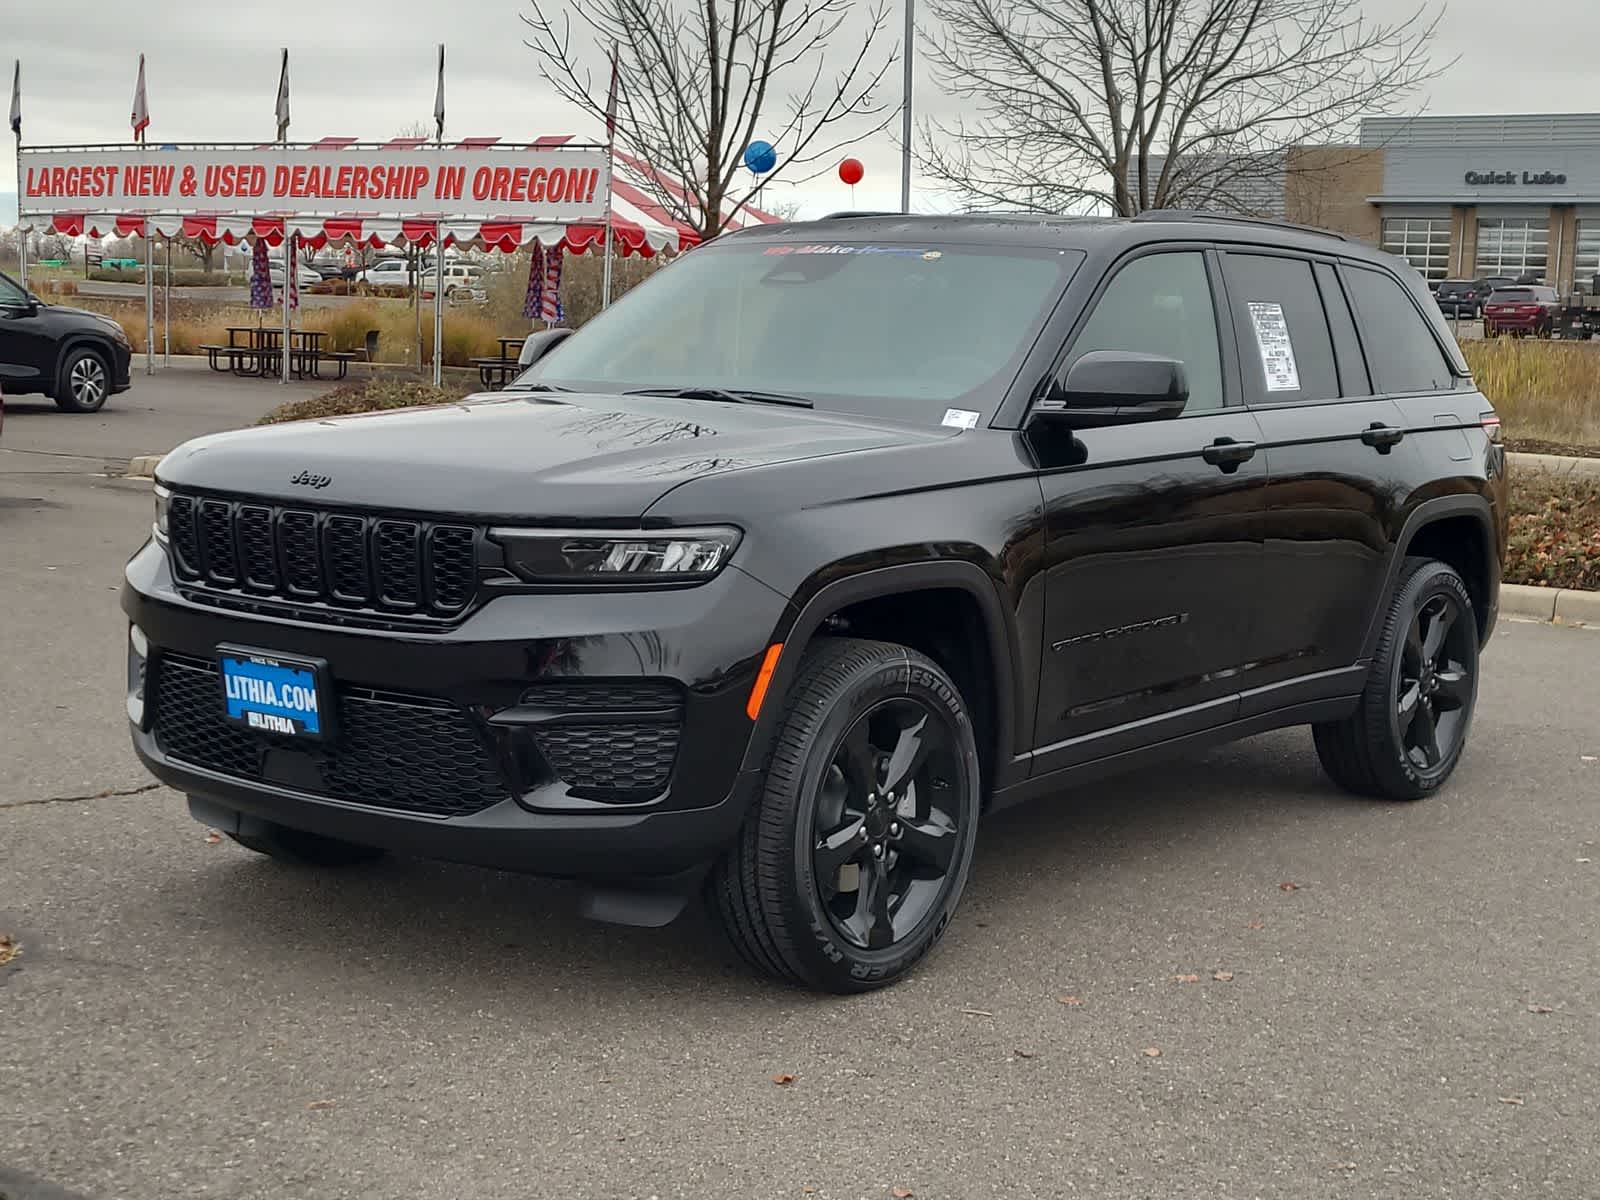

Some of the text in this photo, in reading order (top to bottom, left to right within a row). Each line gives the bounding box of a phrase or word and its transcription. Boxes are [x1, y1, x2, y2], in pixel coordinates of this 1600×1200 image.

[26, 165, 600, 203] LARGEST NEW & USED DEALERSHIP IN OREGON!
[1464, 171, 1567, 185] Quick Lube
[290, 470, 332, 490] Jeep
[224, 673, 318, 713] LITHIA.COM
[258, 712, 296, 735] LITHIA
